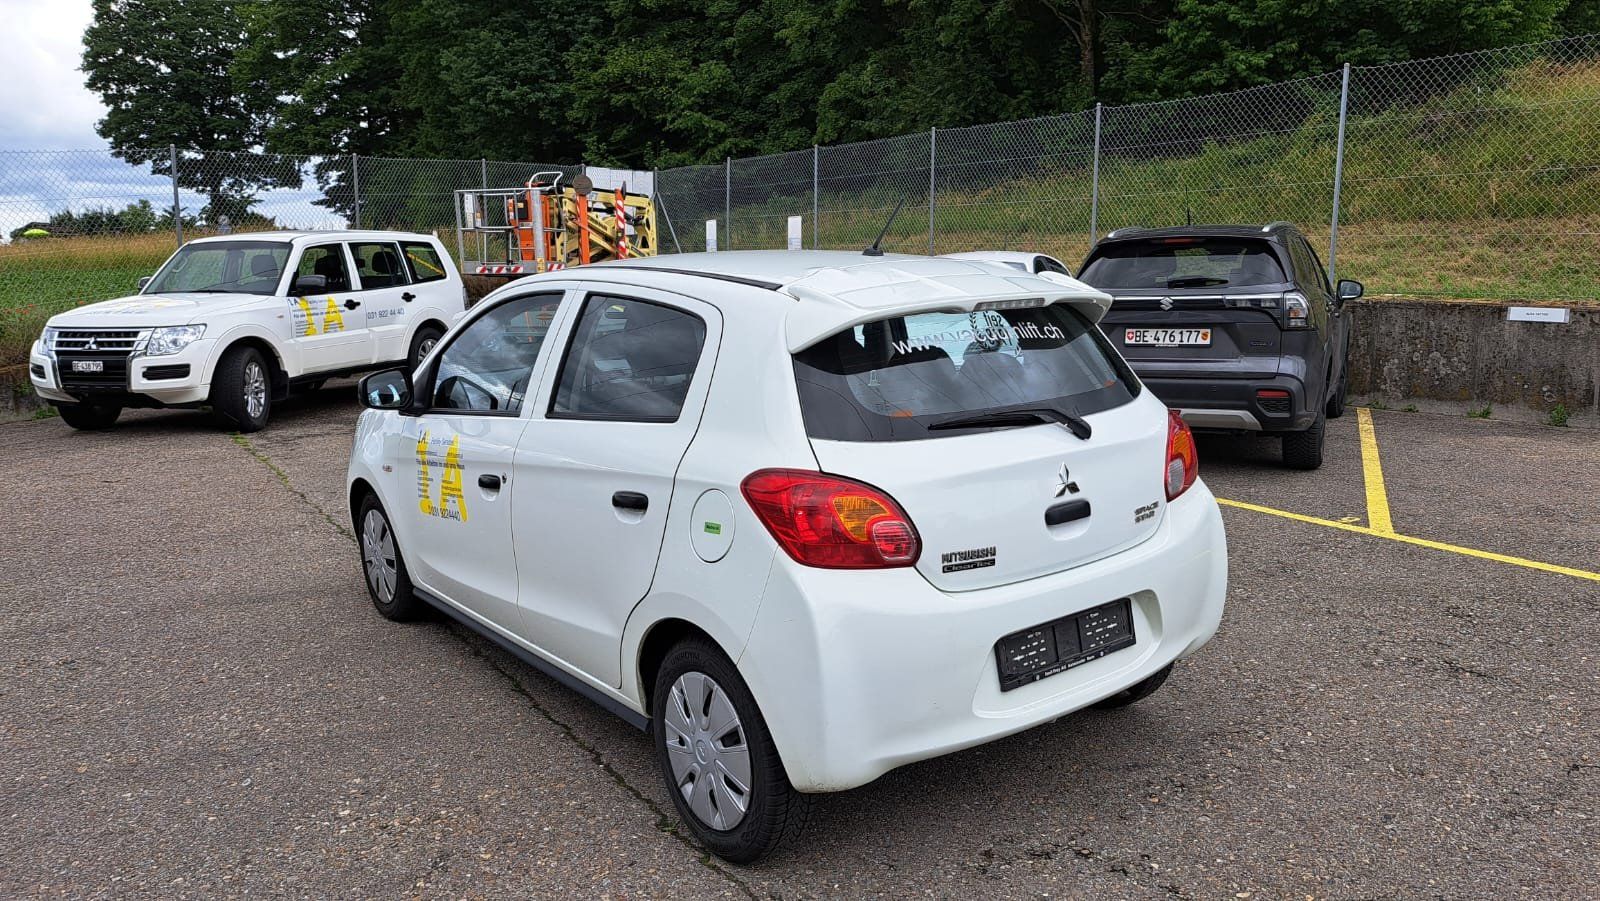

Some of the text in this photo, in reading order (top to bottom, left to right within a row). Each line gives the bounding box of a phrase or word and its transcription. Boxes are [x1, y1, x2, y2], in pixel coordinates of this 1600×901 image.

[368, 307, 405, 319] 031 922 44 40
[1134, 501, 1159, 515] SPACE
[1134, 511, 1155, 523] STAR
[941, 546, 996, 564] MITSUBISHI
[943, 560, 995, 572] ClearTec
